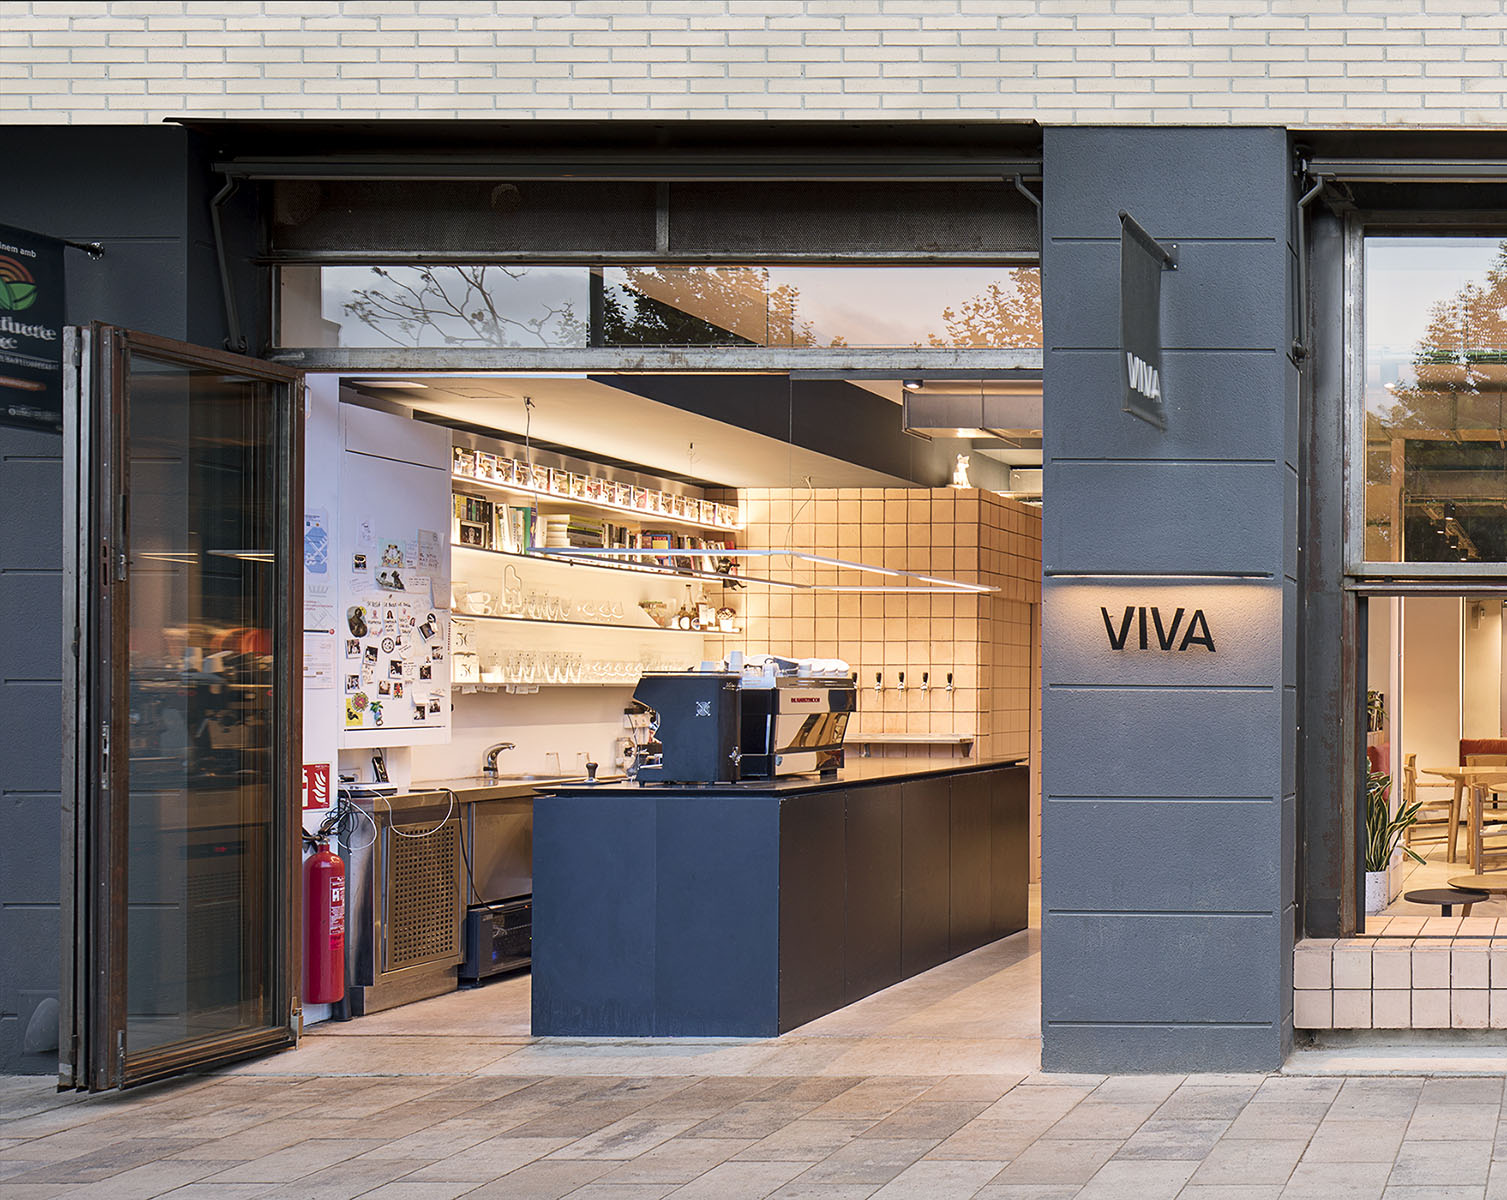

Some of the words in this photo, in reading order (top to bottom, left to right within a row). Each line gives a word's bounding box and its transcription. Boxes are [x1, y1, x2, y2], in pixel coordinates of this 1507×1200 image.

[20, 248, 37, 258] amb
[1127, 351, 1162, 403] VIVA
[1100, 606, 1217, 652] VIVA
